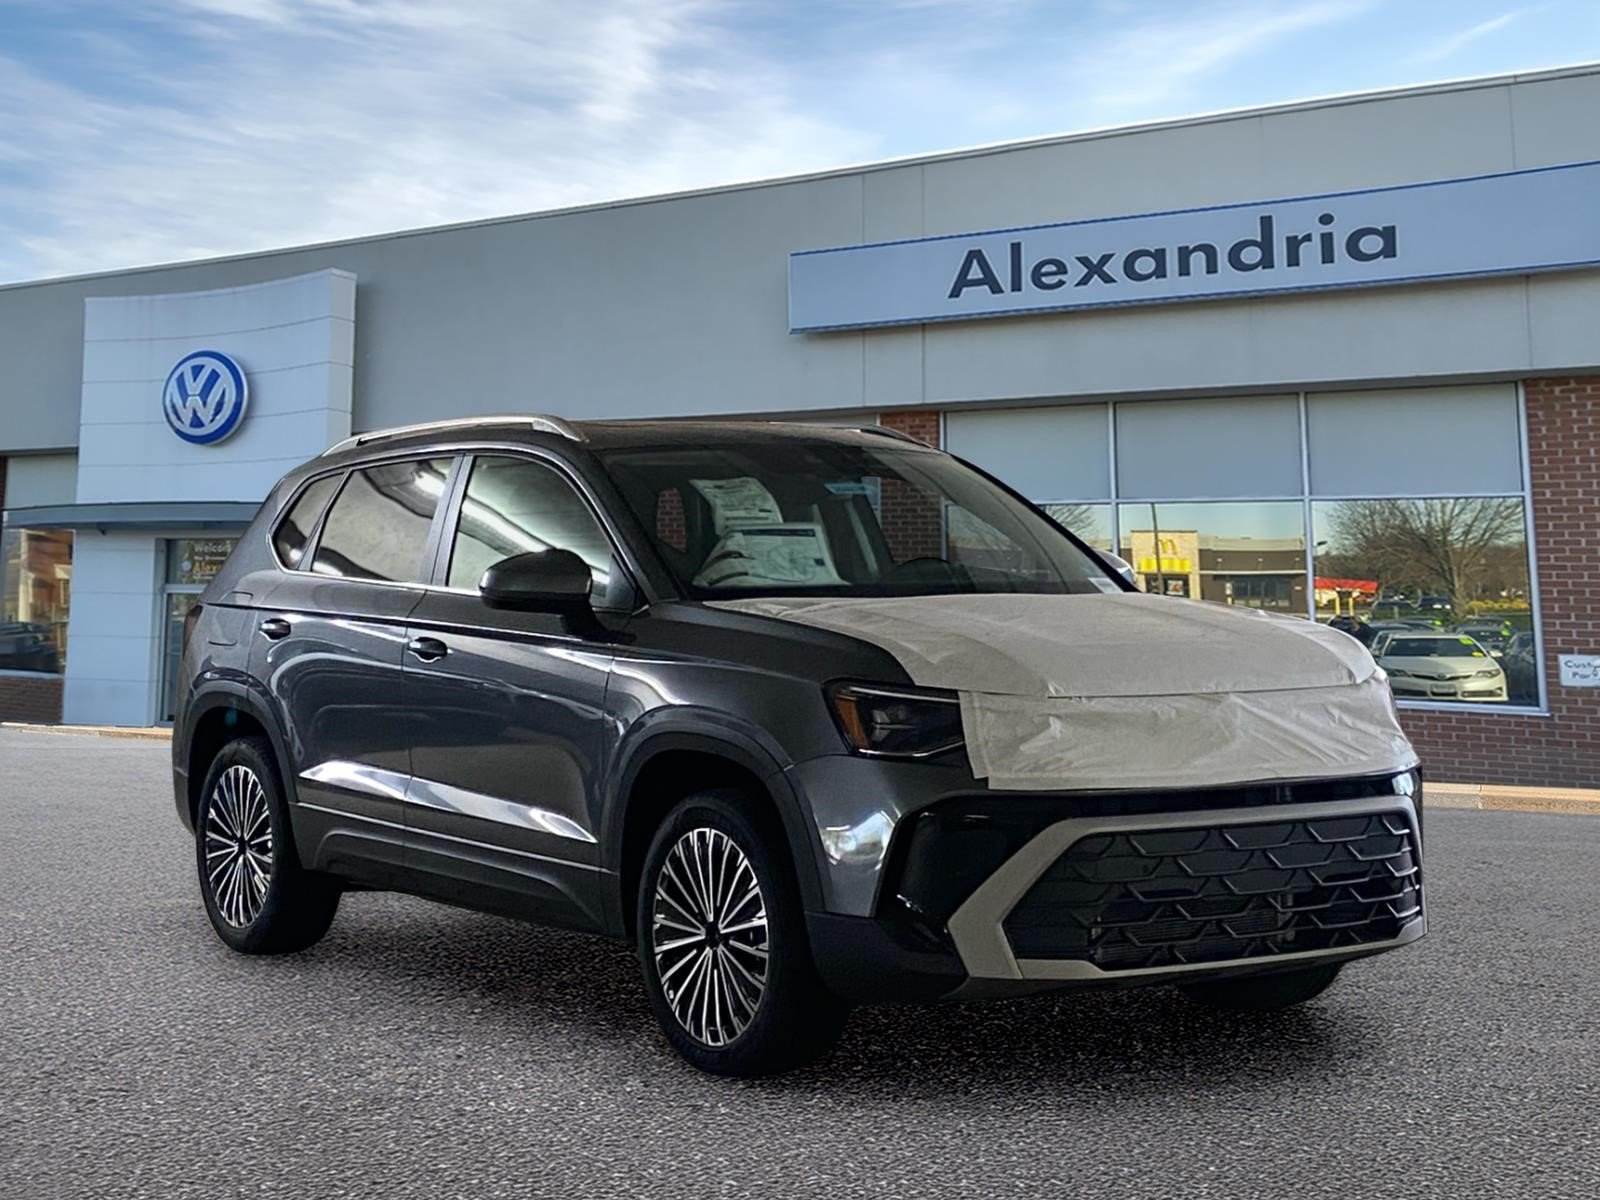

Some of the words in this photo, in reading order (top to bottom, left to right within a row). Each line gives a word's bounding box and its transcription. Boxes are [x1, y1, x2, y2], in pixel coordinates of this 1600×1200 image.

[948, 213, 1398, 299] Alexandria
[166, 358, 234, 435] VW
[193, 561, 222, 573] Alex
